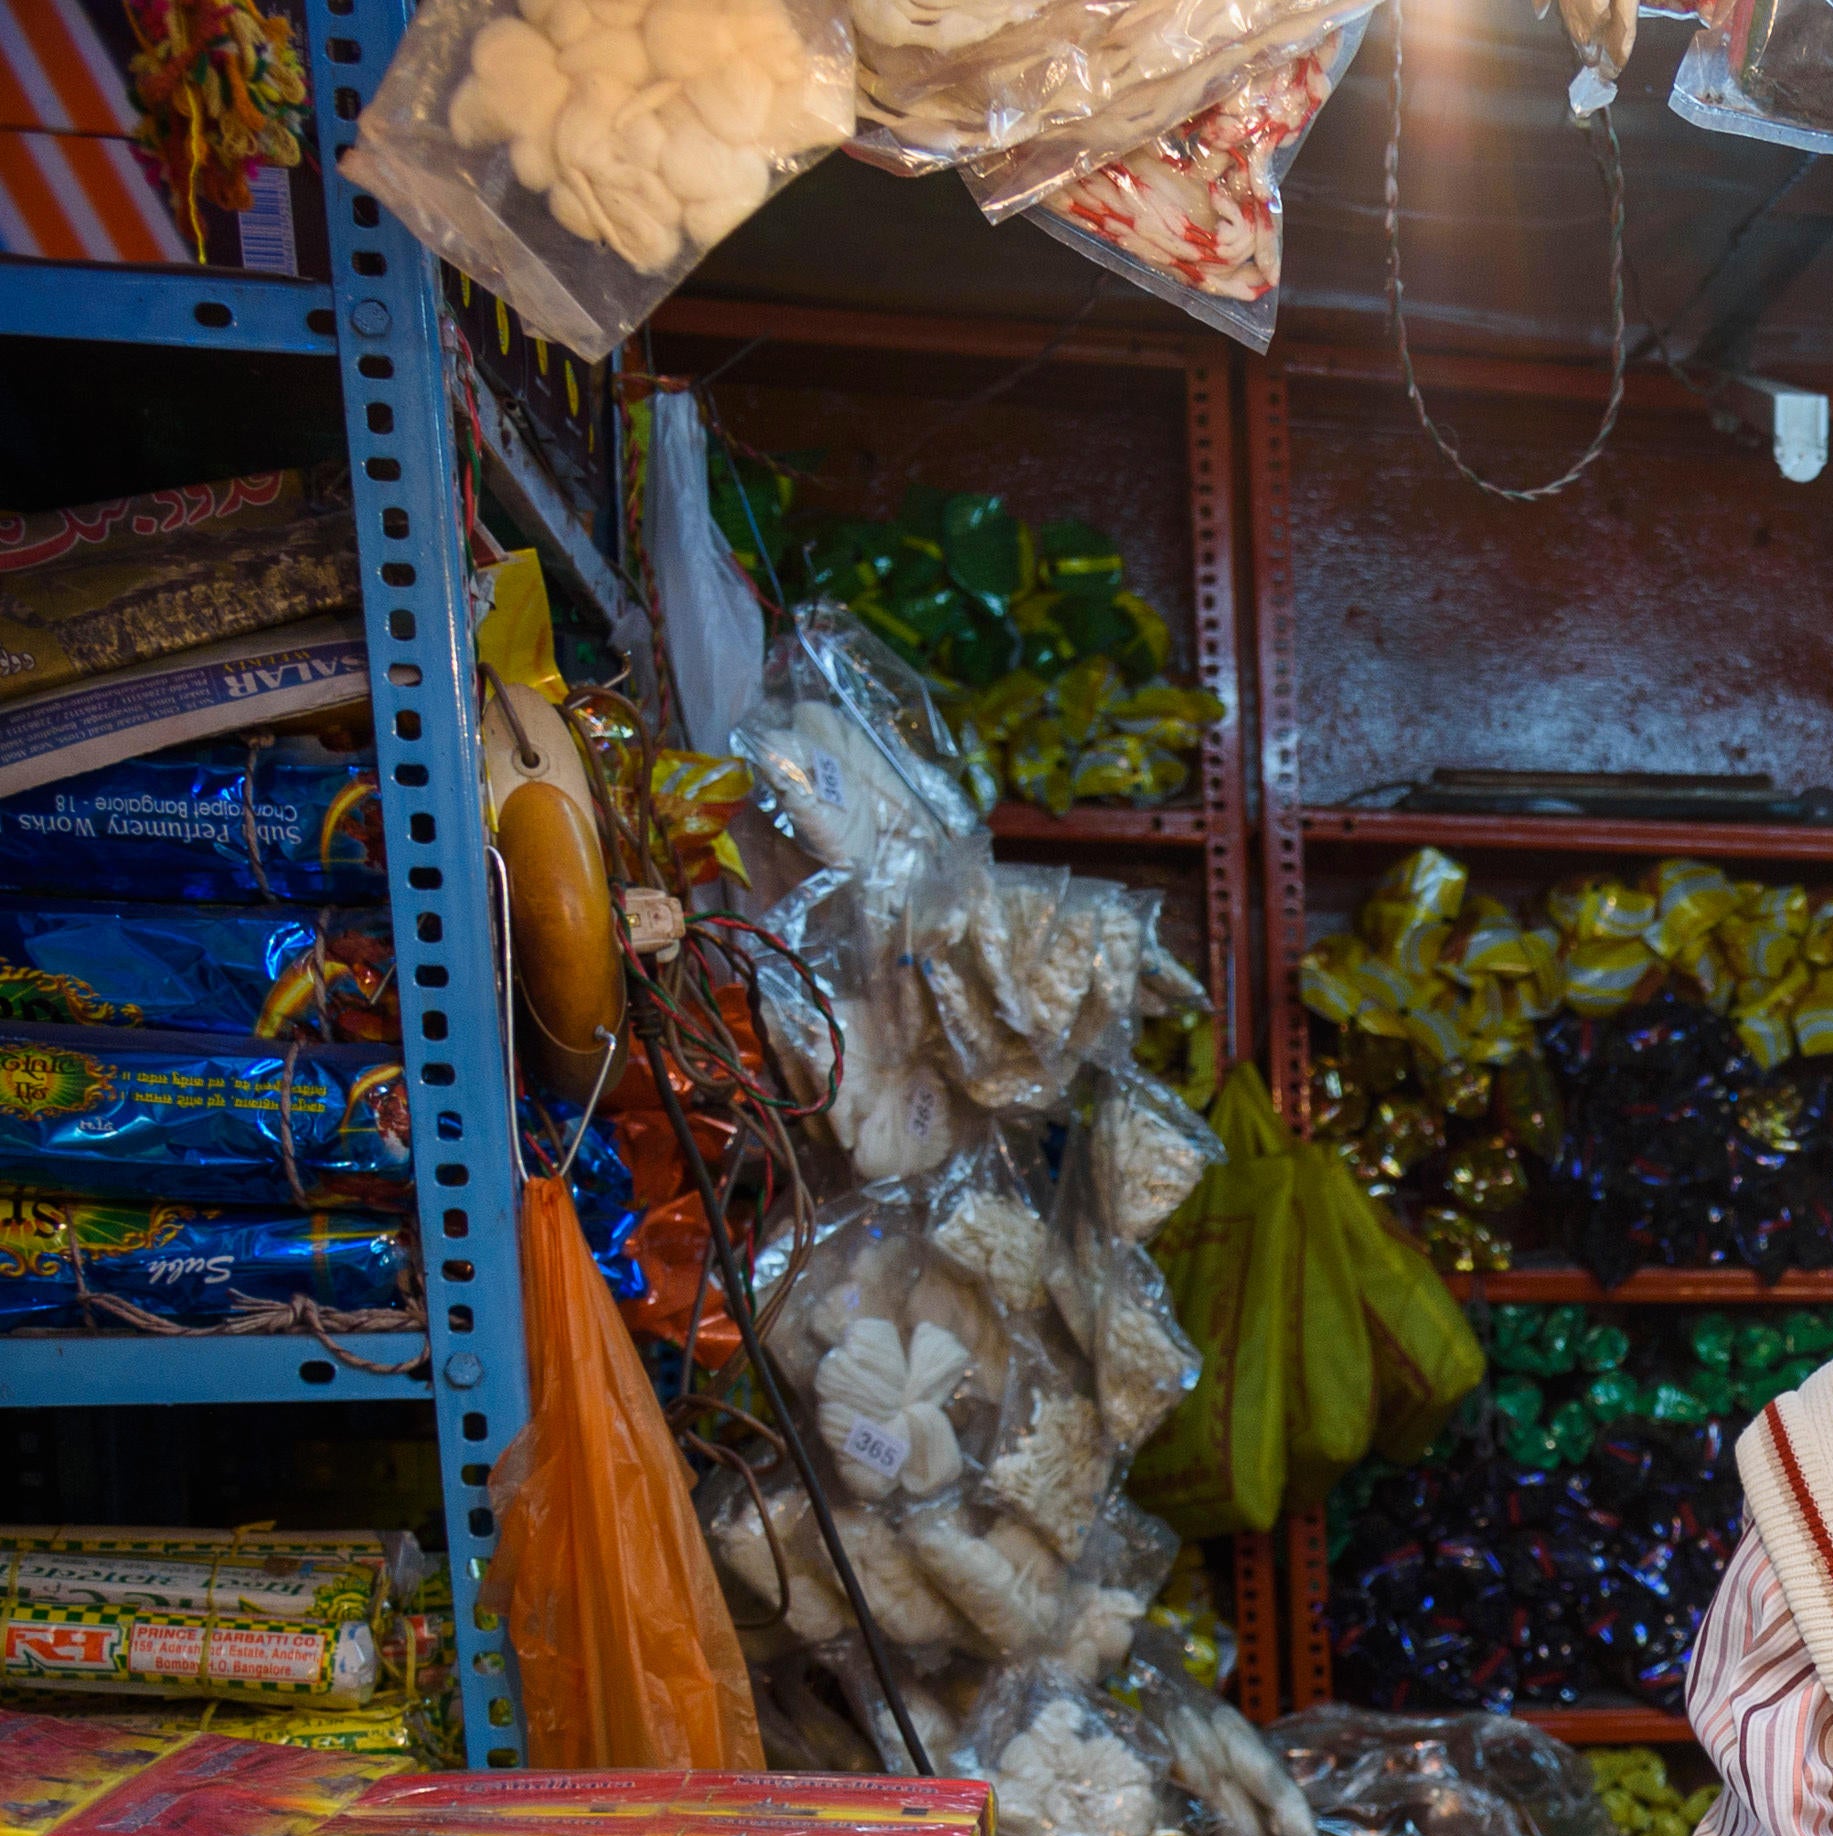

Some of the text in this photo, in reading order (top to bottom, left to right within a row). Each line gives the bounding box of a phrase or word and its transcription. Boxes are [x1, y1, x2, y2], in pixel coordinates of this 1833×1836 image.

[55, 795, 75, 813] 18
[95, 795, 188, 818] Bangalore
[18, 813, 96, 838] Works
[107, 812, 231, 844] Perfumery
[147, 1256, 235, 1285] Subh
[856, 1430, 898, 1467] 365
[137, 1626, 197, 1642] PRINCE
[203, 1629, 290, 1647] GARBATTI
